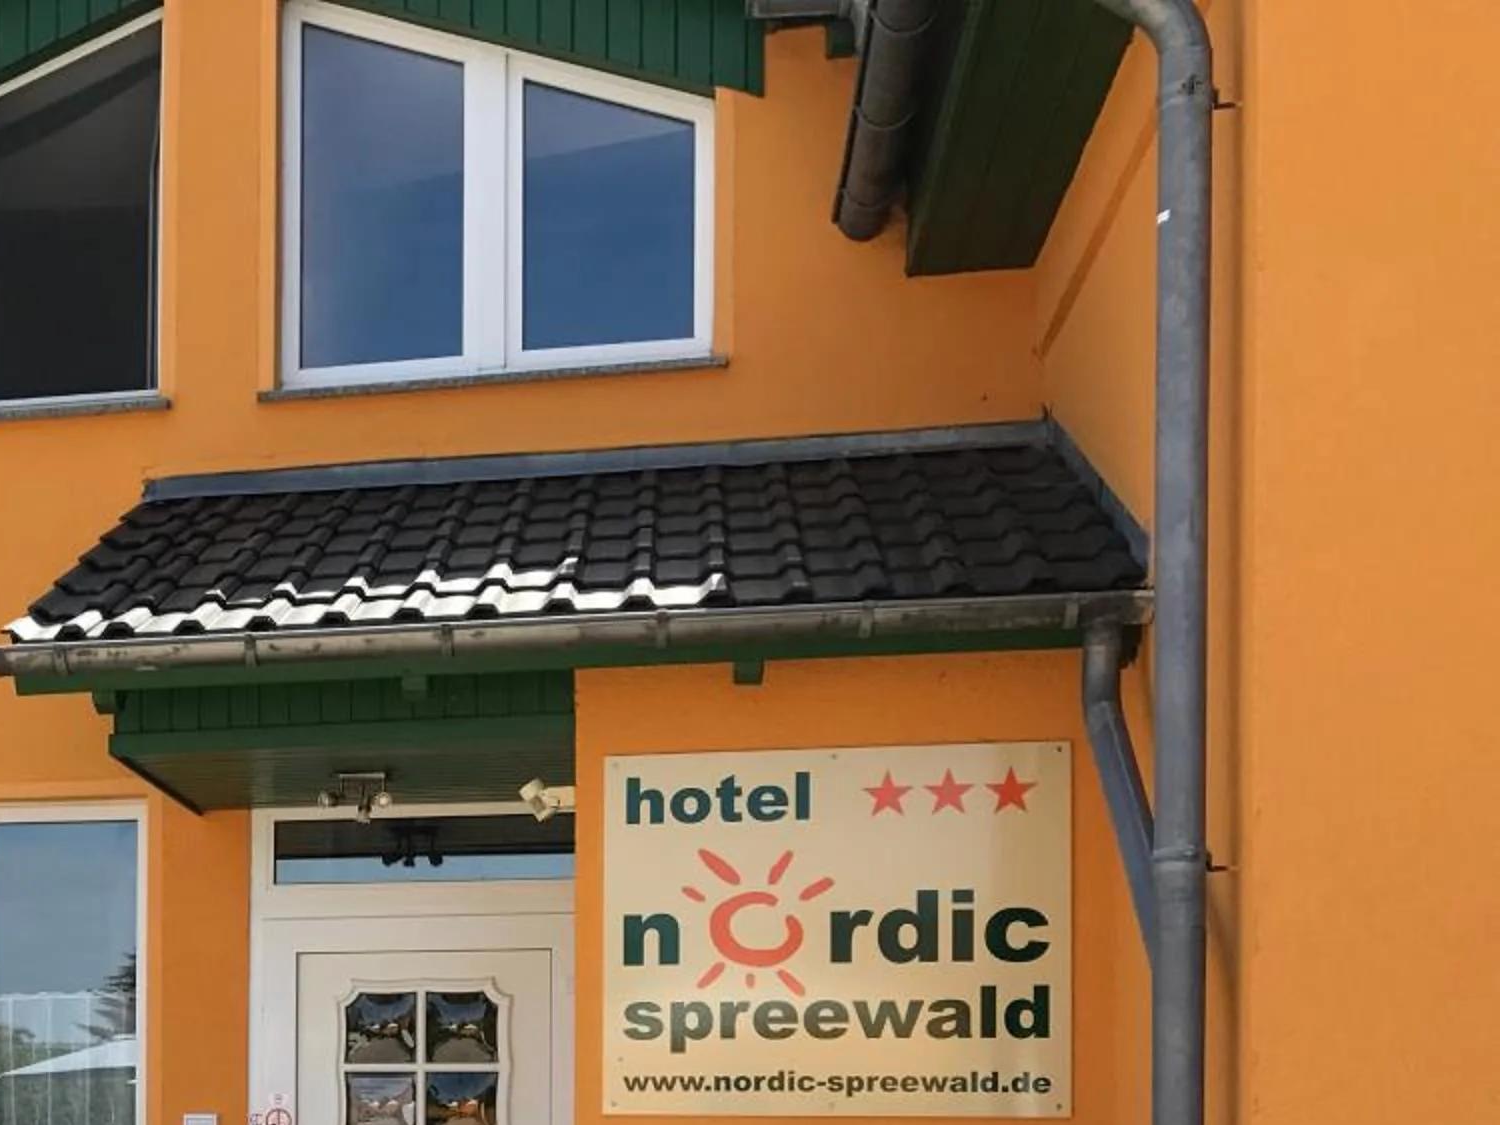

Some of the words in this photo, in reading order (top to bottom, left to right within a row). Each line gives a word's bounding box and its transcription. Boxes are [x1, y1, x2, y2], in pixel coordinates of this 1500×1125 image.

[625, 771, 810, 824] hotel
[623, 984, 1050, 1053] spreewald
[623, 1071, 1051, 1097] www.nordic-spreewald.de
